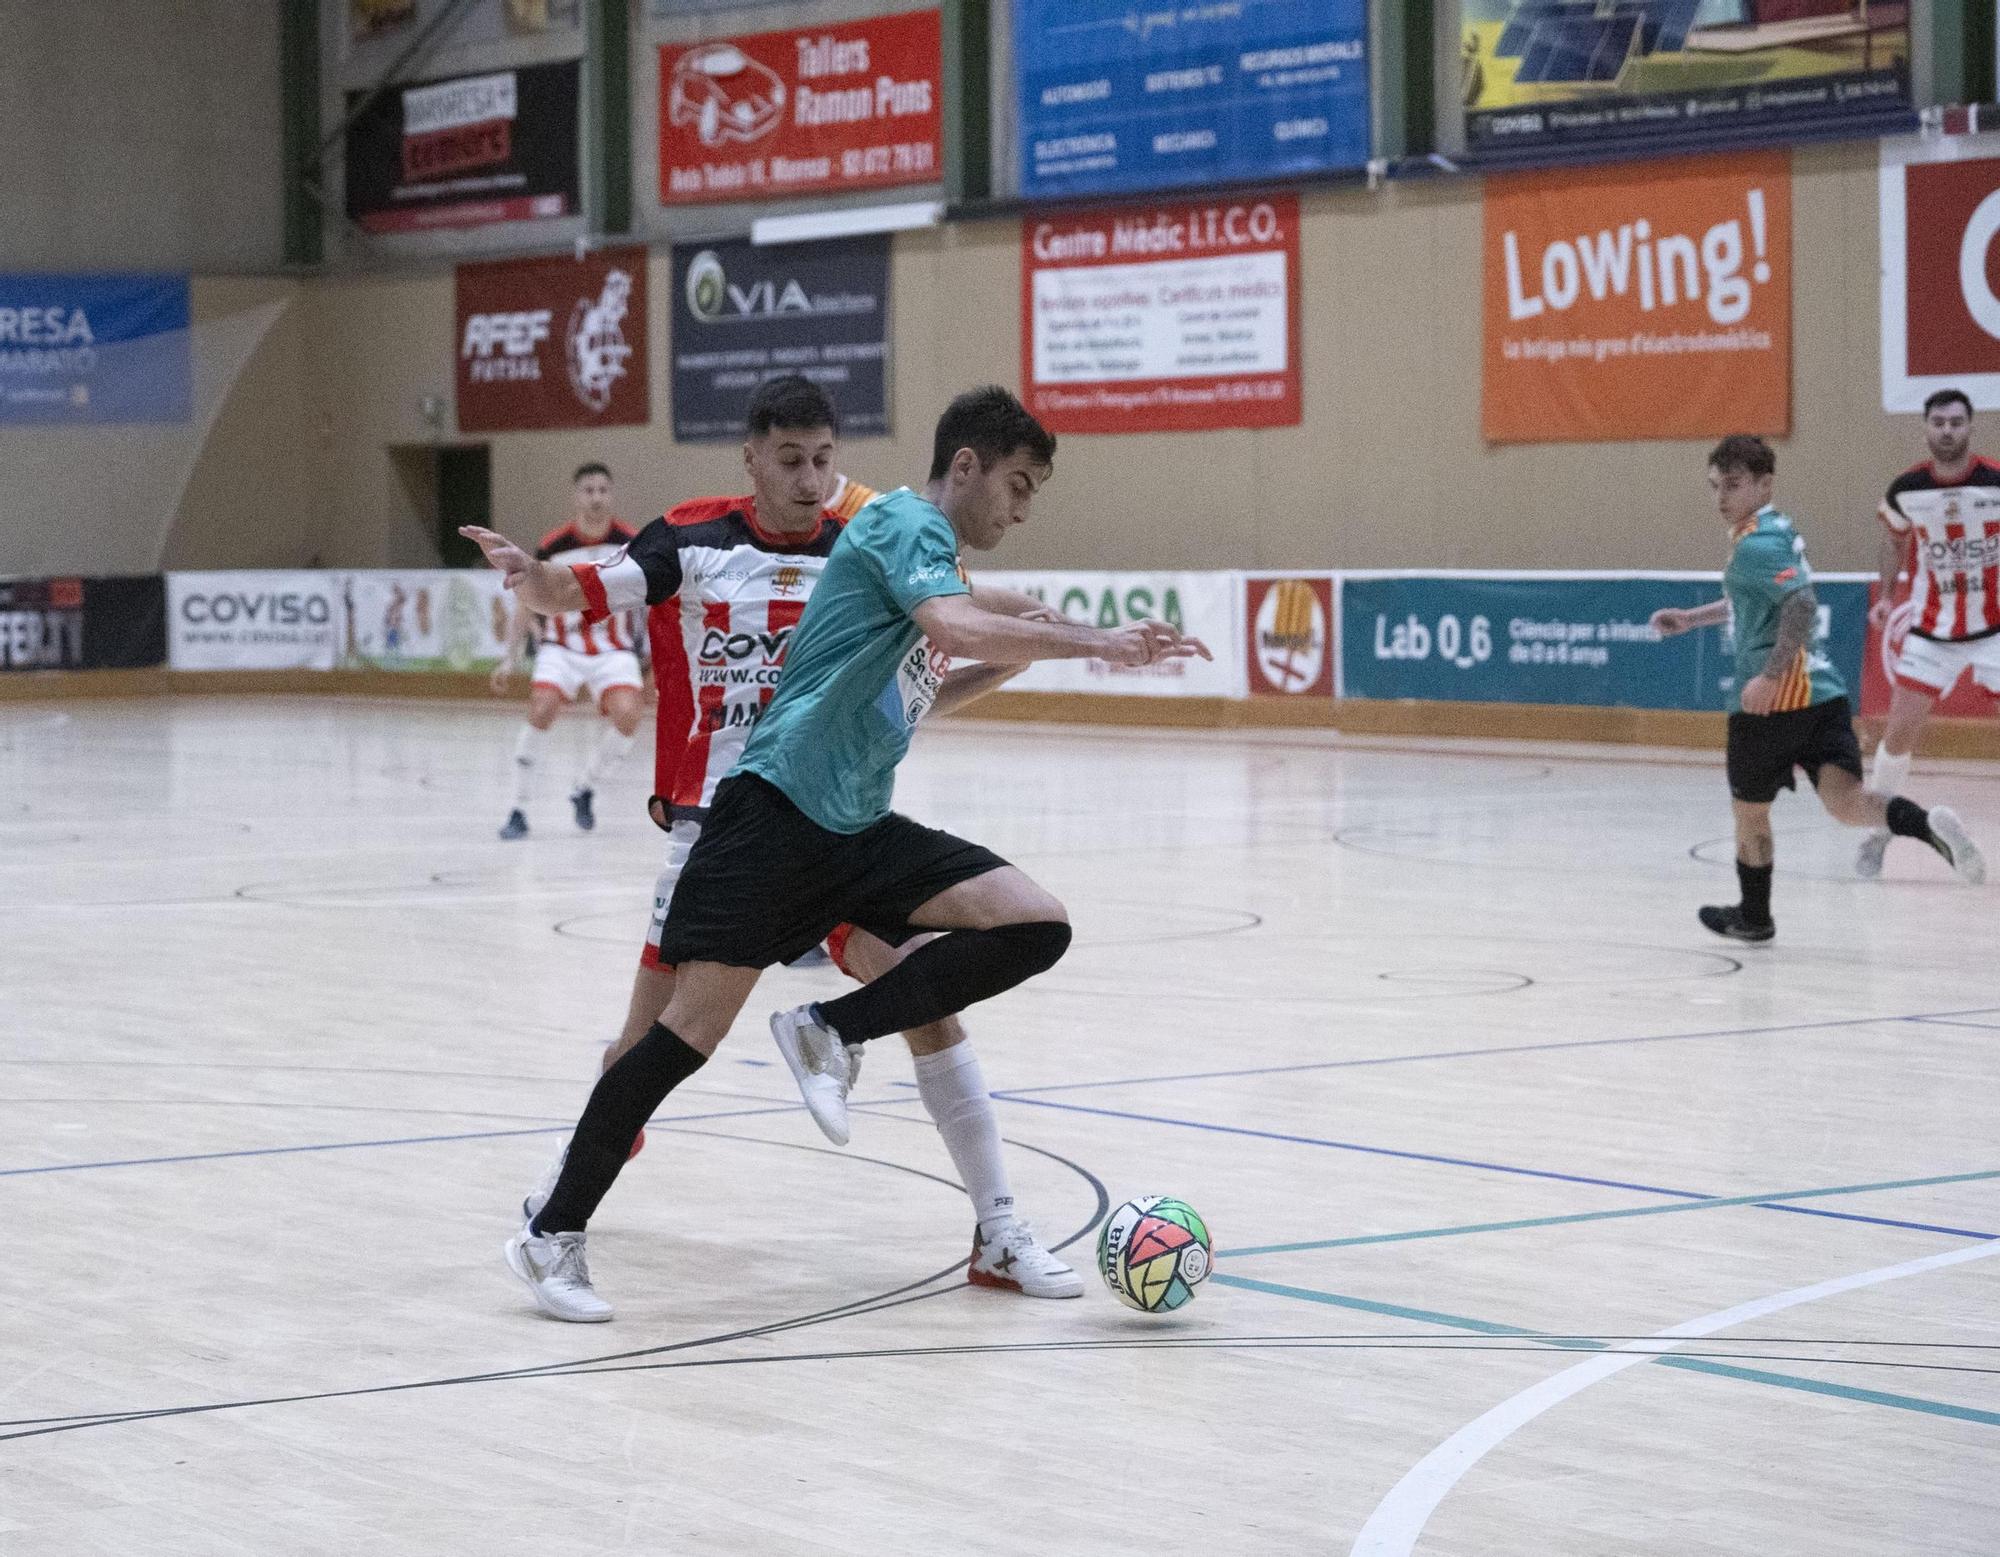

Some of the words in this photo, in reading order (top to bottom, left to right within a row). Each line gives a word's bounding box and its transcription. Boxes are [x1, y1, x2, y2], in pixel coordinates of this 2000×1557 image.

[796, 36, 870, 77] Tallers
[794, 85, 873, 126] Ramon
[876, 75, 933, 118] Pons
[1034, 223, 1108, 260] Centre
[726, 278, 814, 319] VIA
[1374, 613, 1432, 660] Lab
[1437, 614, 1492, 669] 0_6
